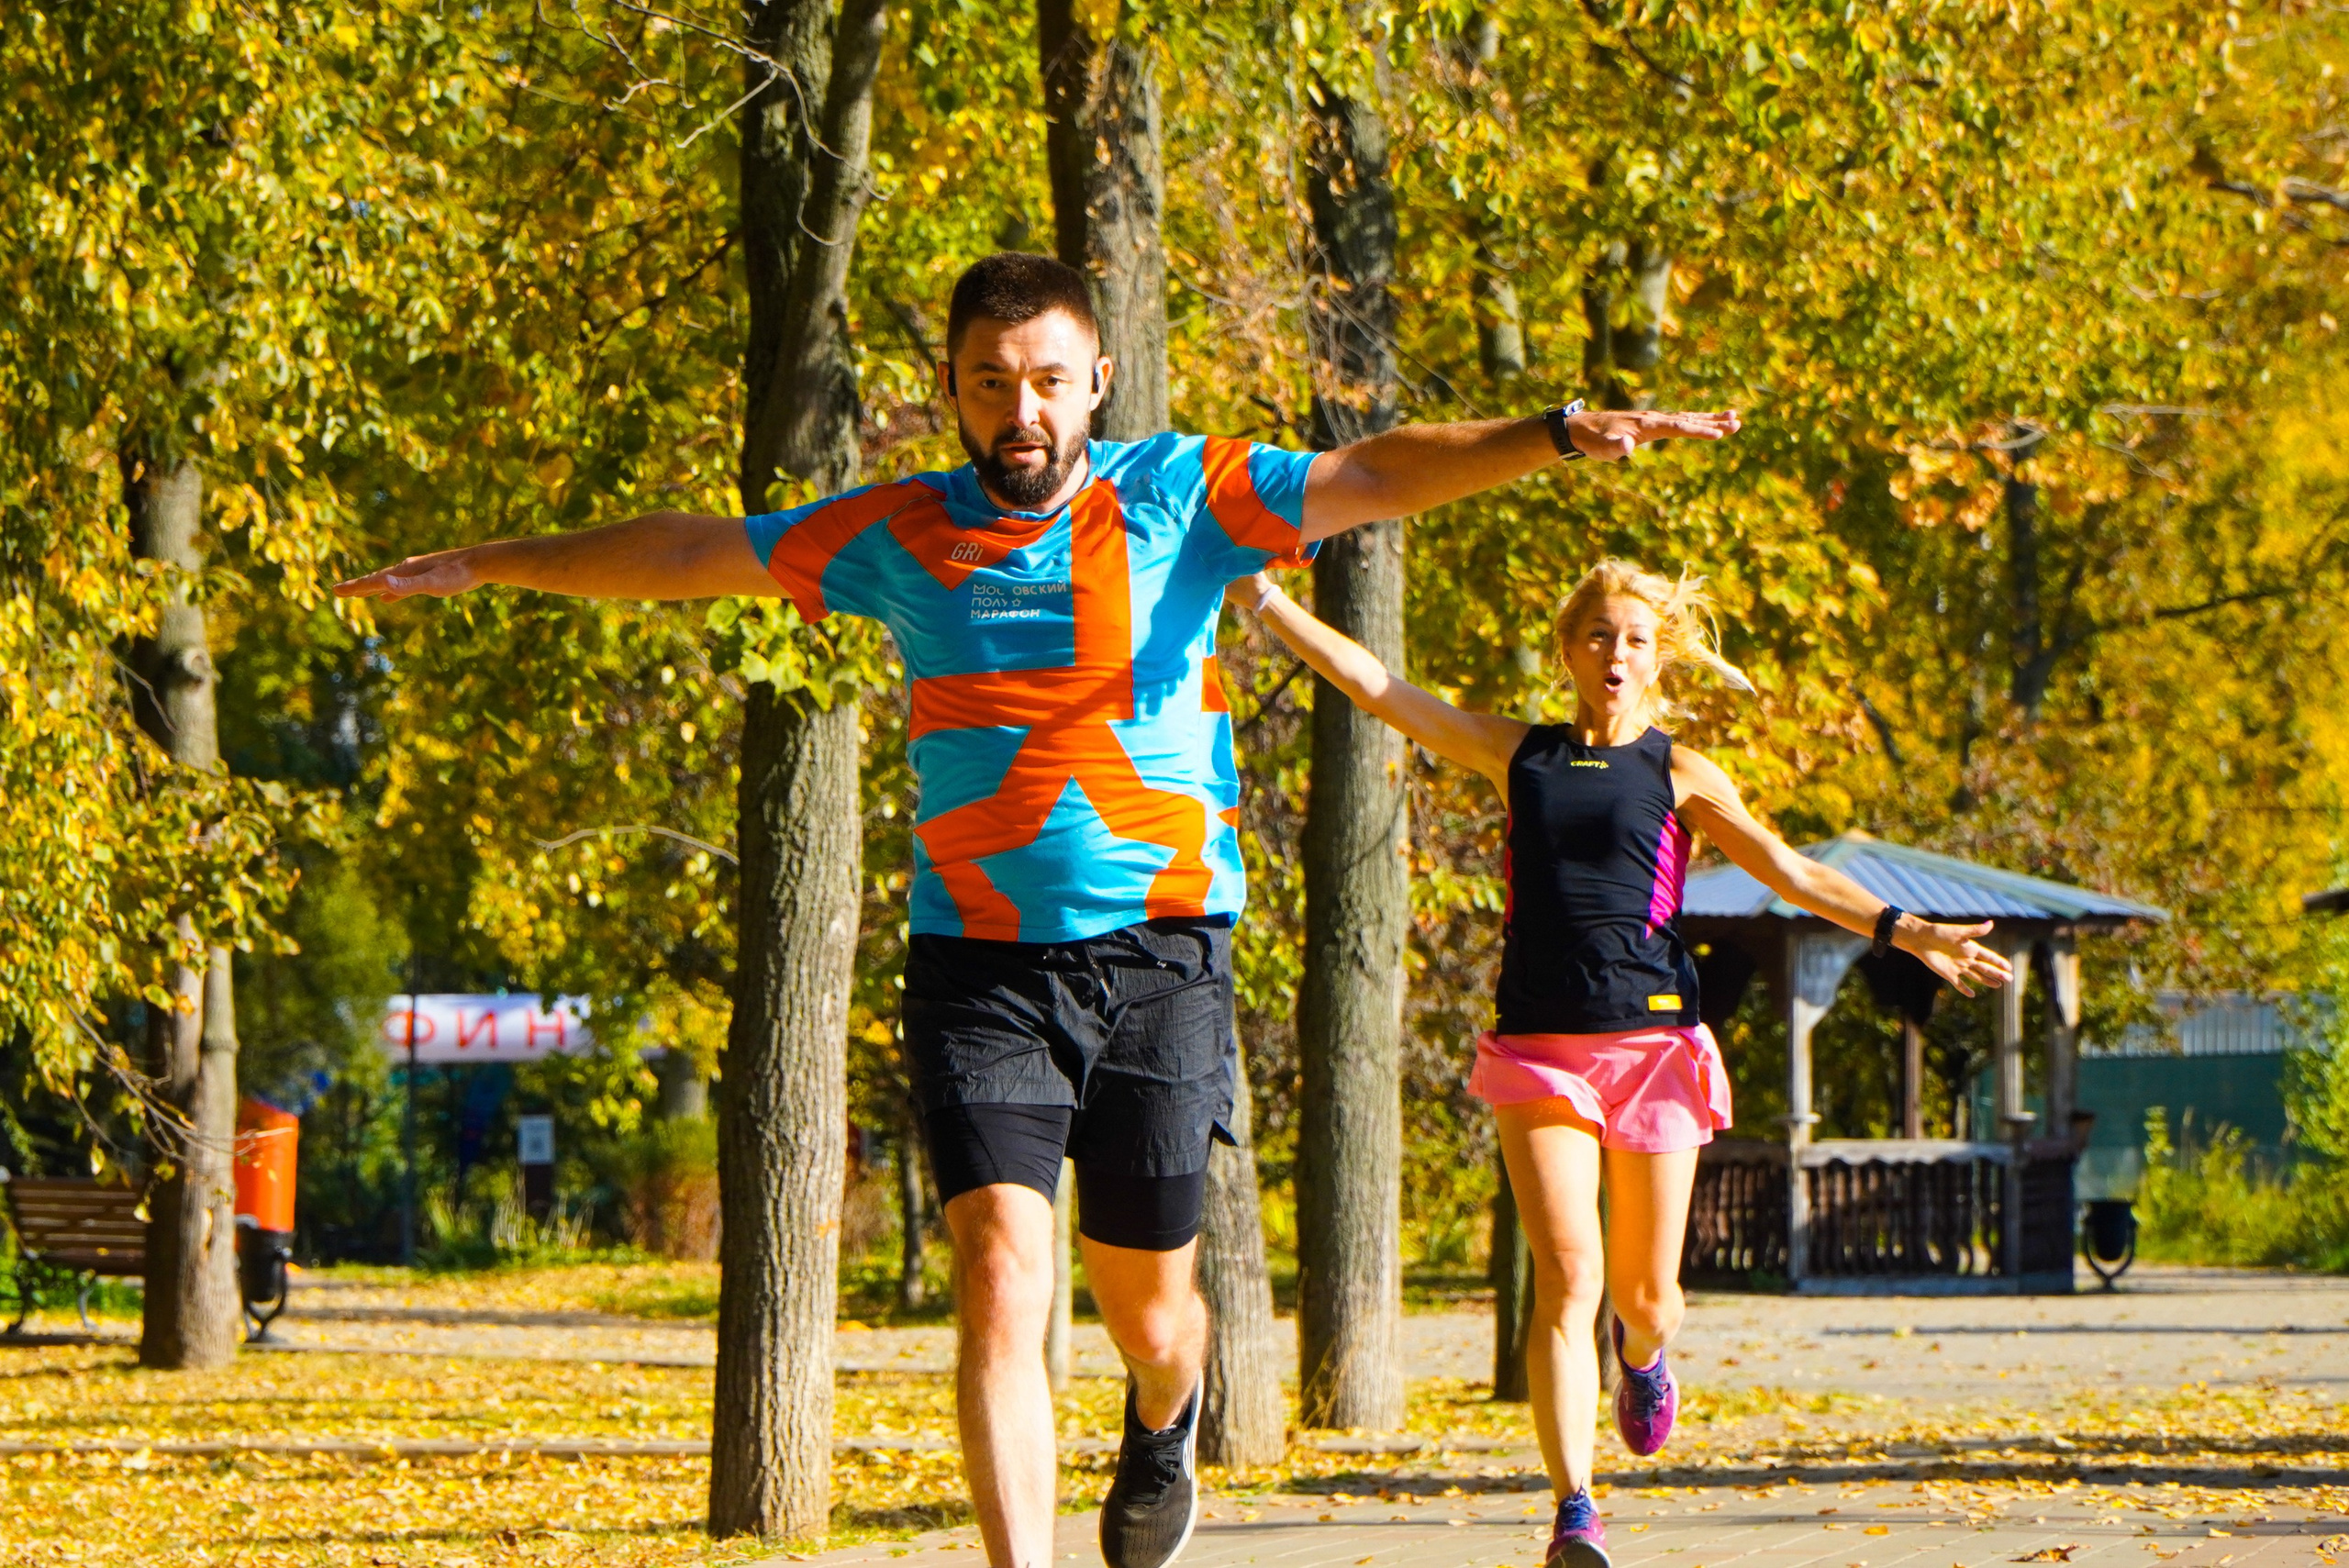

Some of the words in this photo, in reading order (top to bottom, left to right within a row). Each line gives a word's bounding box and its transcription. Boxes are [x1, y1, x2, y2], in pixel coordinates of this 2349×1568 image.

[973, 580, 1067, 596] МОСОВСКИЙ
[971, 596, 1008, 607] ПОЛУ
[970, 608, 1041, 619] МАРАФОН
[1570, 760, 1601, 768] CRAFT
[382, 1008, 567, 1049] ФИН
